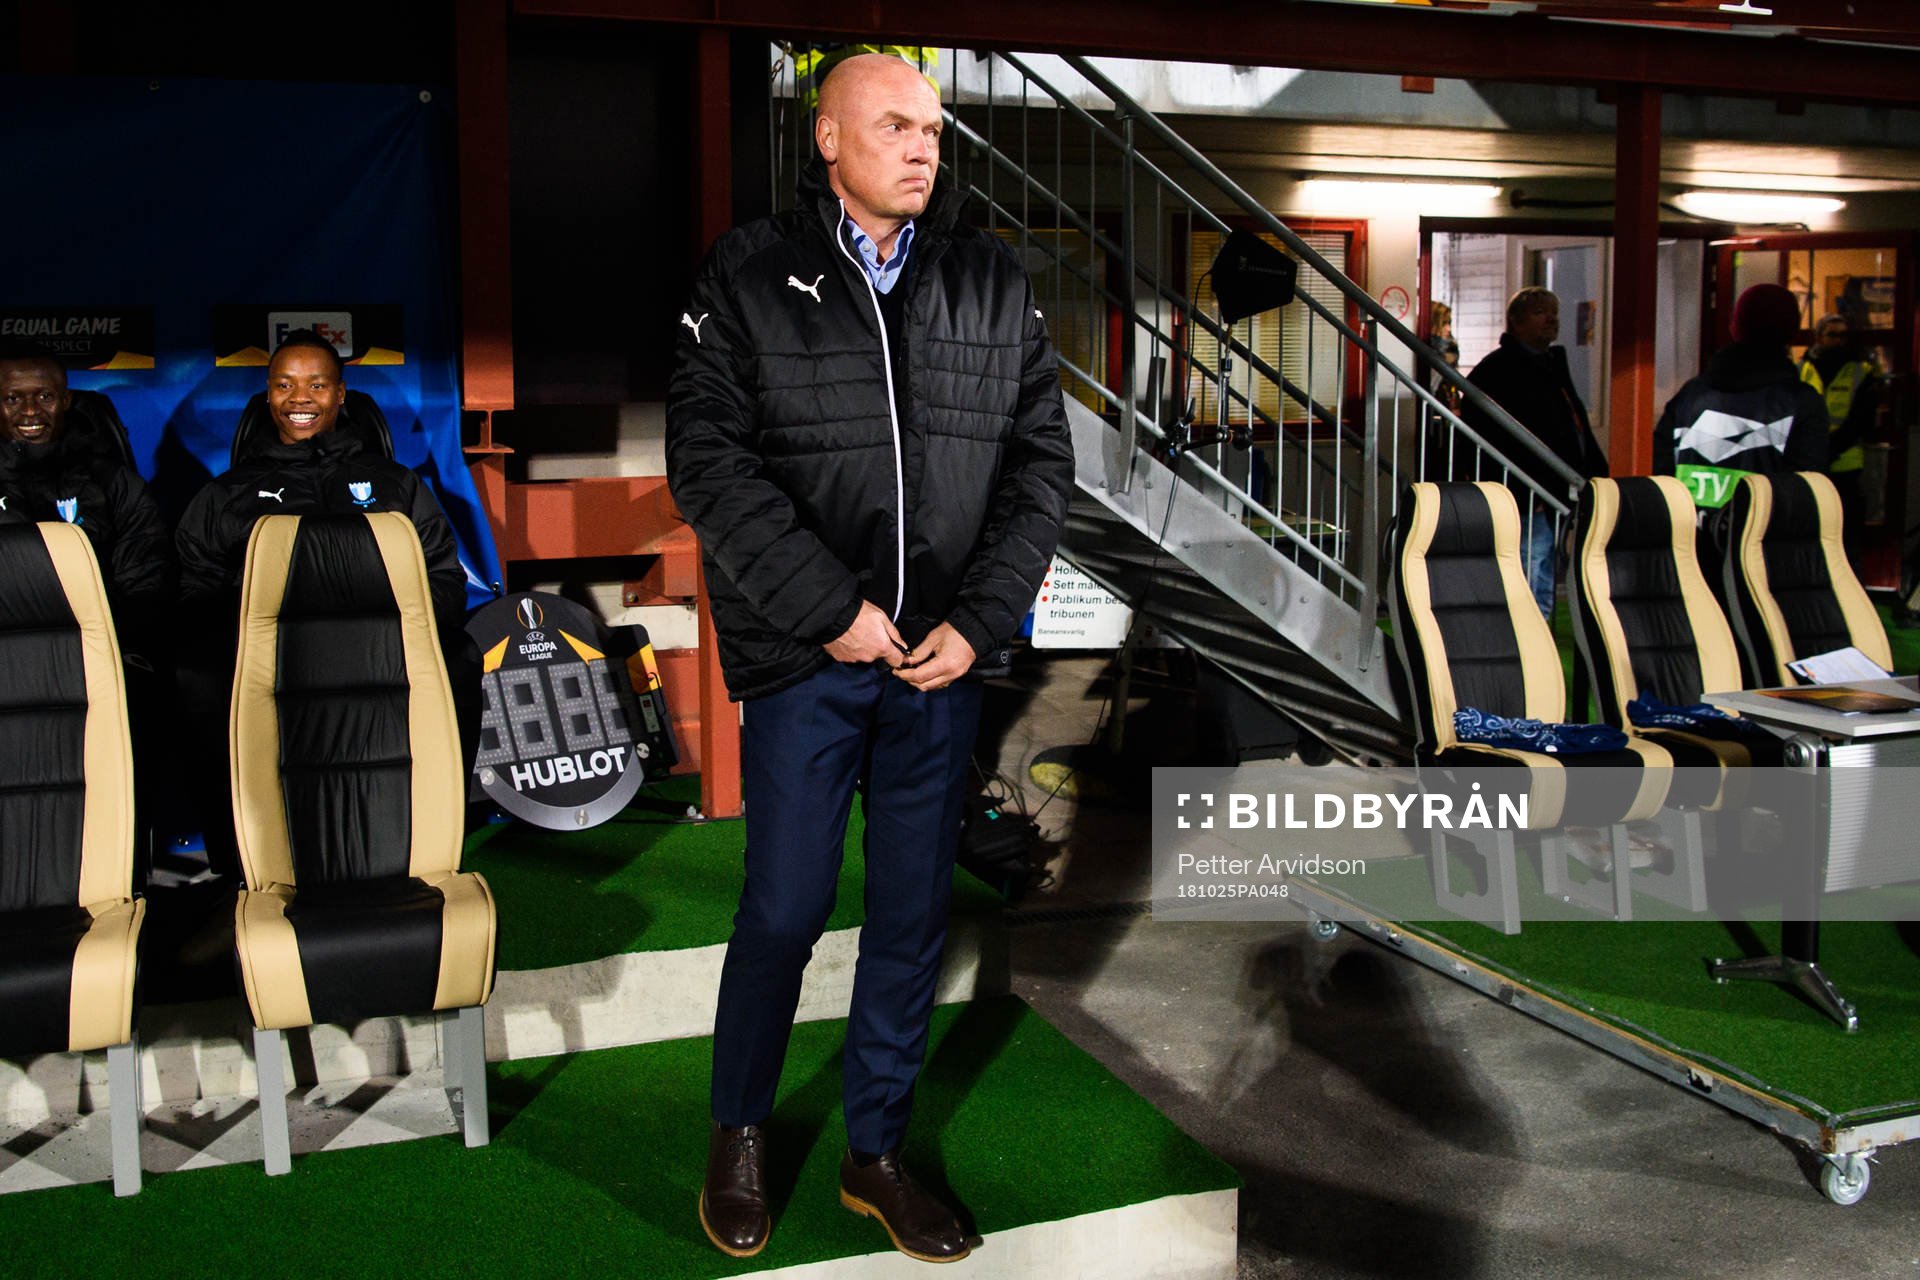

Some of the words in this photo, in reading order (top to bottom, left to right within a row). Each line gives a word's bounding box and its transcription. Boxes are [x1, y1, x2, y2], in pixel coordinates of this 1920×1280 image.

[1, 317, 62, 336] EQUAL
[64, 315, 121, 336] GAME
[276, 323, 347, 345] FEx
[1690, 471, 1731, 502] TV
[1053, 580, 1075, 590] Sett
[1052, 594, 1102, 605] Publikum
[1050, 609, 1095, 619] tribunen
[526, 631, 546, 642] UEFA
[519, 641, 558, 655] EUROPA
[528, 652, 553, 661] LEAGUE
[510, 747, 626, 791] HUBLOT
